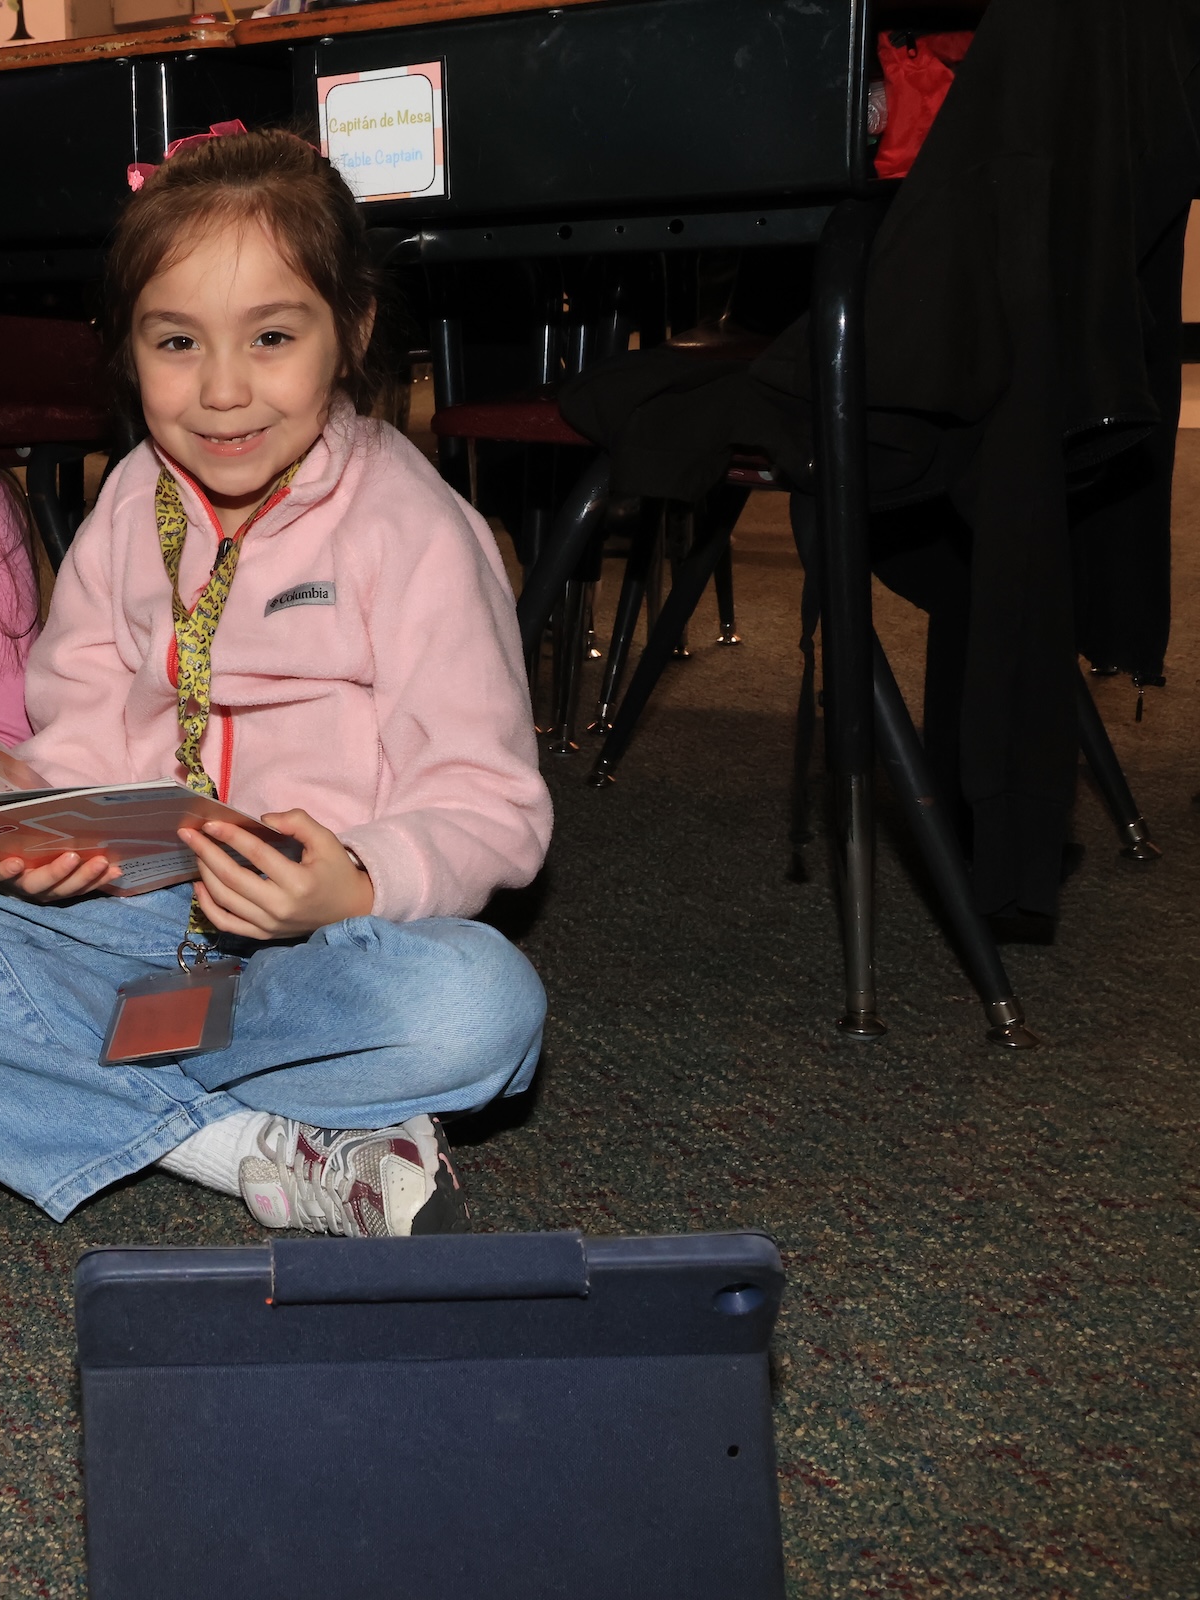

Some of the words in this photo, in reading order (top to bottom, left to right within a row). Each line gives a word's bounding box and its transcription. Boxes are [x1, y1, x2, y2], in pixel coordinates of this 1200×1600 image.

[329, 115, 377, 136] Capitán
[380, 113, 394, 128] de
[398, 110, 431, 125] Mesa
[341, 151, 371, 168] Table
[375, 148, 422, 168] Captain
[280, 588, 328, 604] Columbia
